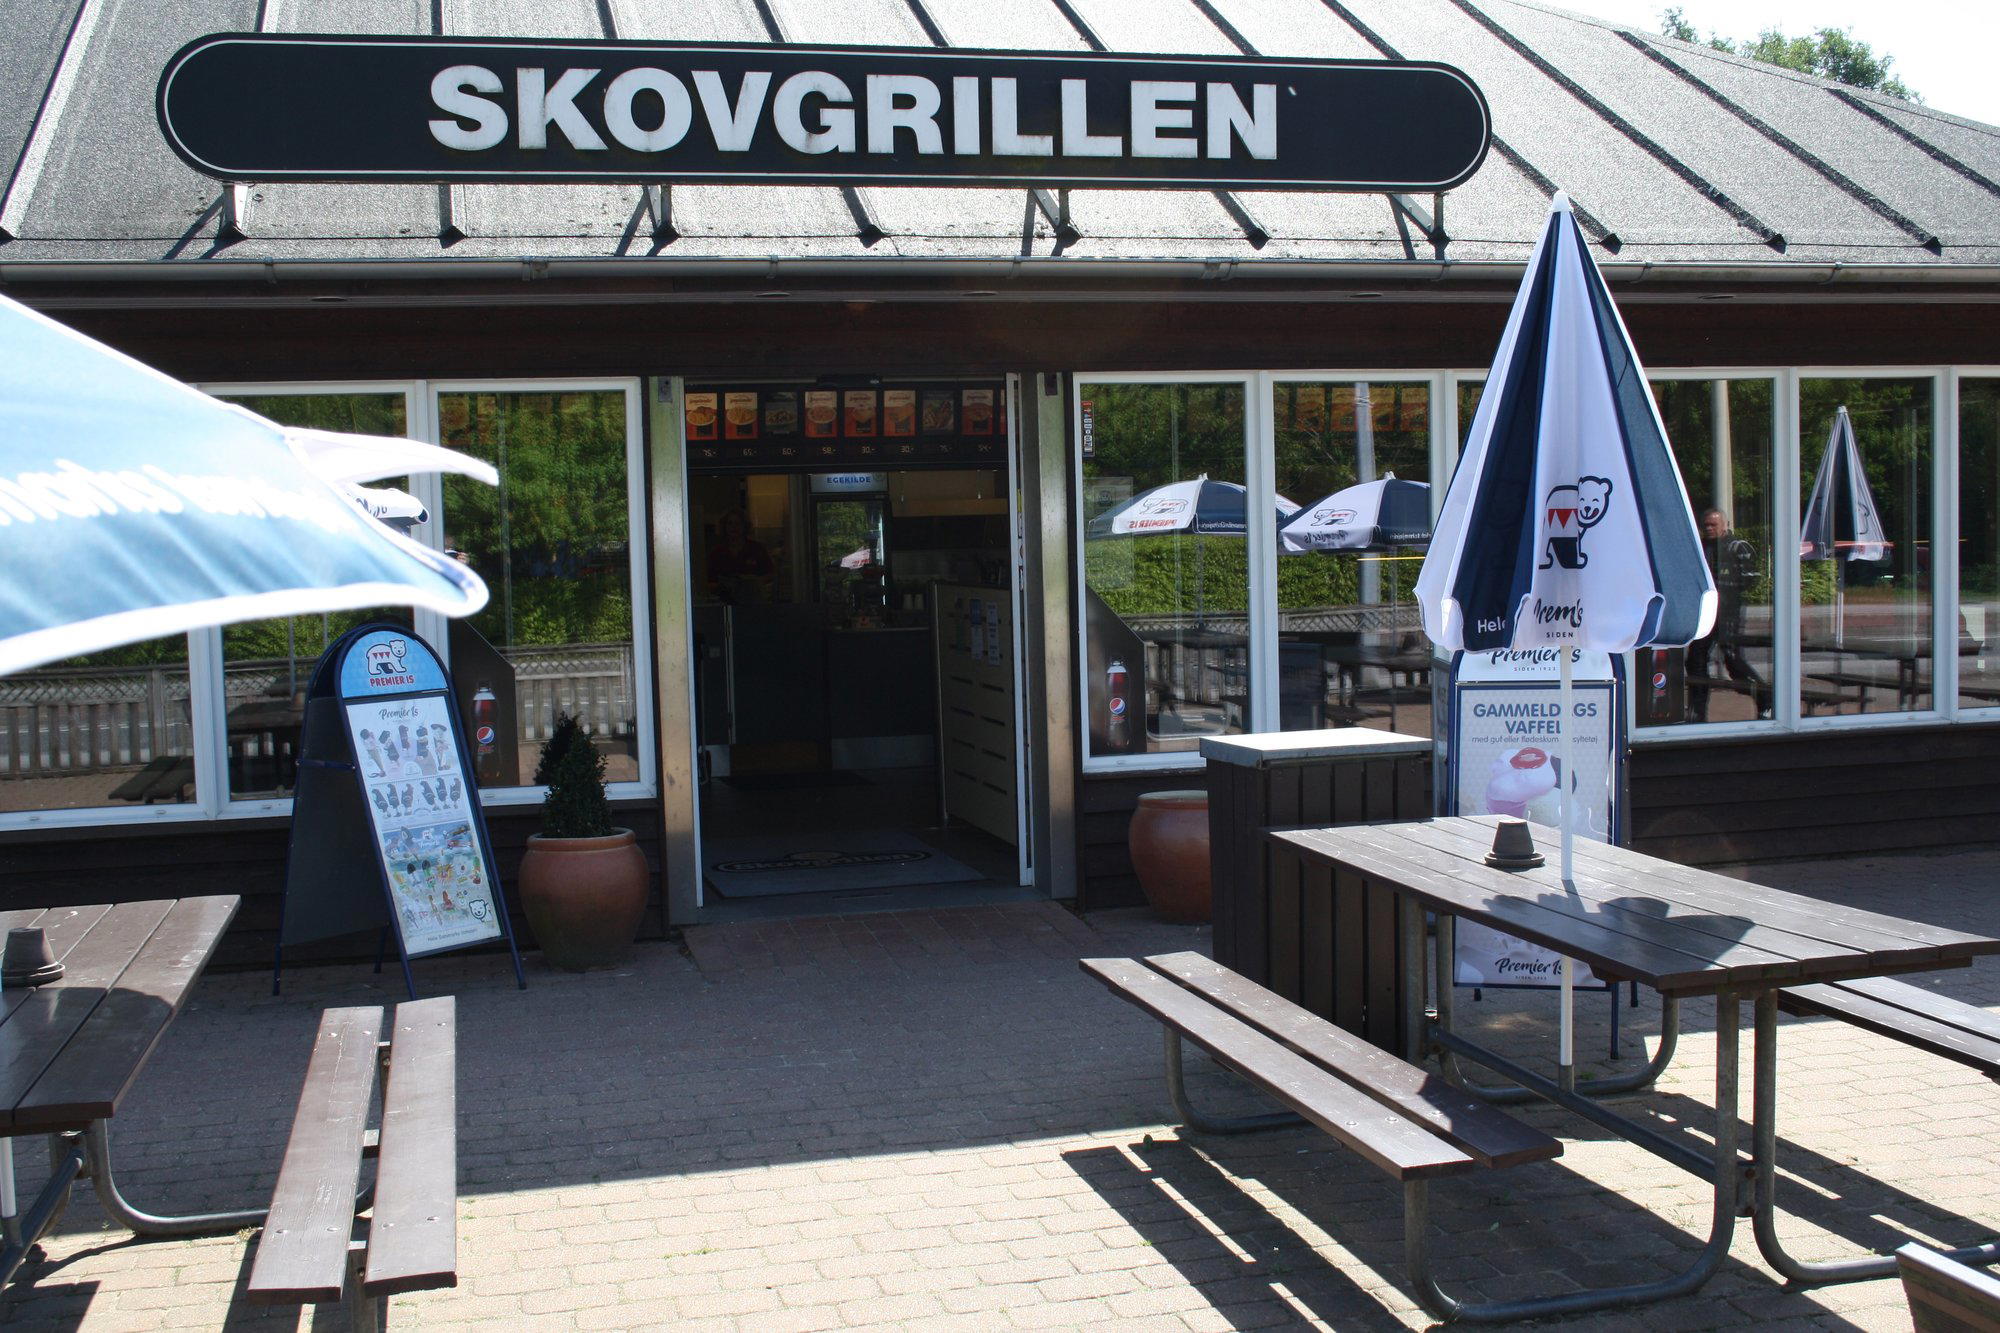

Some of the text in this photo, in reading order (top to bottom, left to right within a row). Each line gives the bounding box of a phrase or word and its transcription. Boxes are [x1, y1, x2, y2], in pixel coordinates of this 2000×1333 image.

[429, 64, 1278, 160] SKOVGRILLEN
[1487, 646, 1561, 665] Premier
[369, 674, 415, 687] PREMIER IS
[1473, 702, 1598, 717] GAMMELDGS
[1495, 958, 1551, 975] Premier
